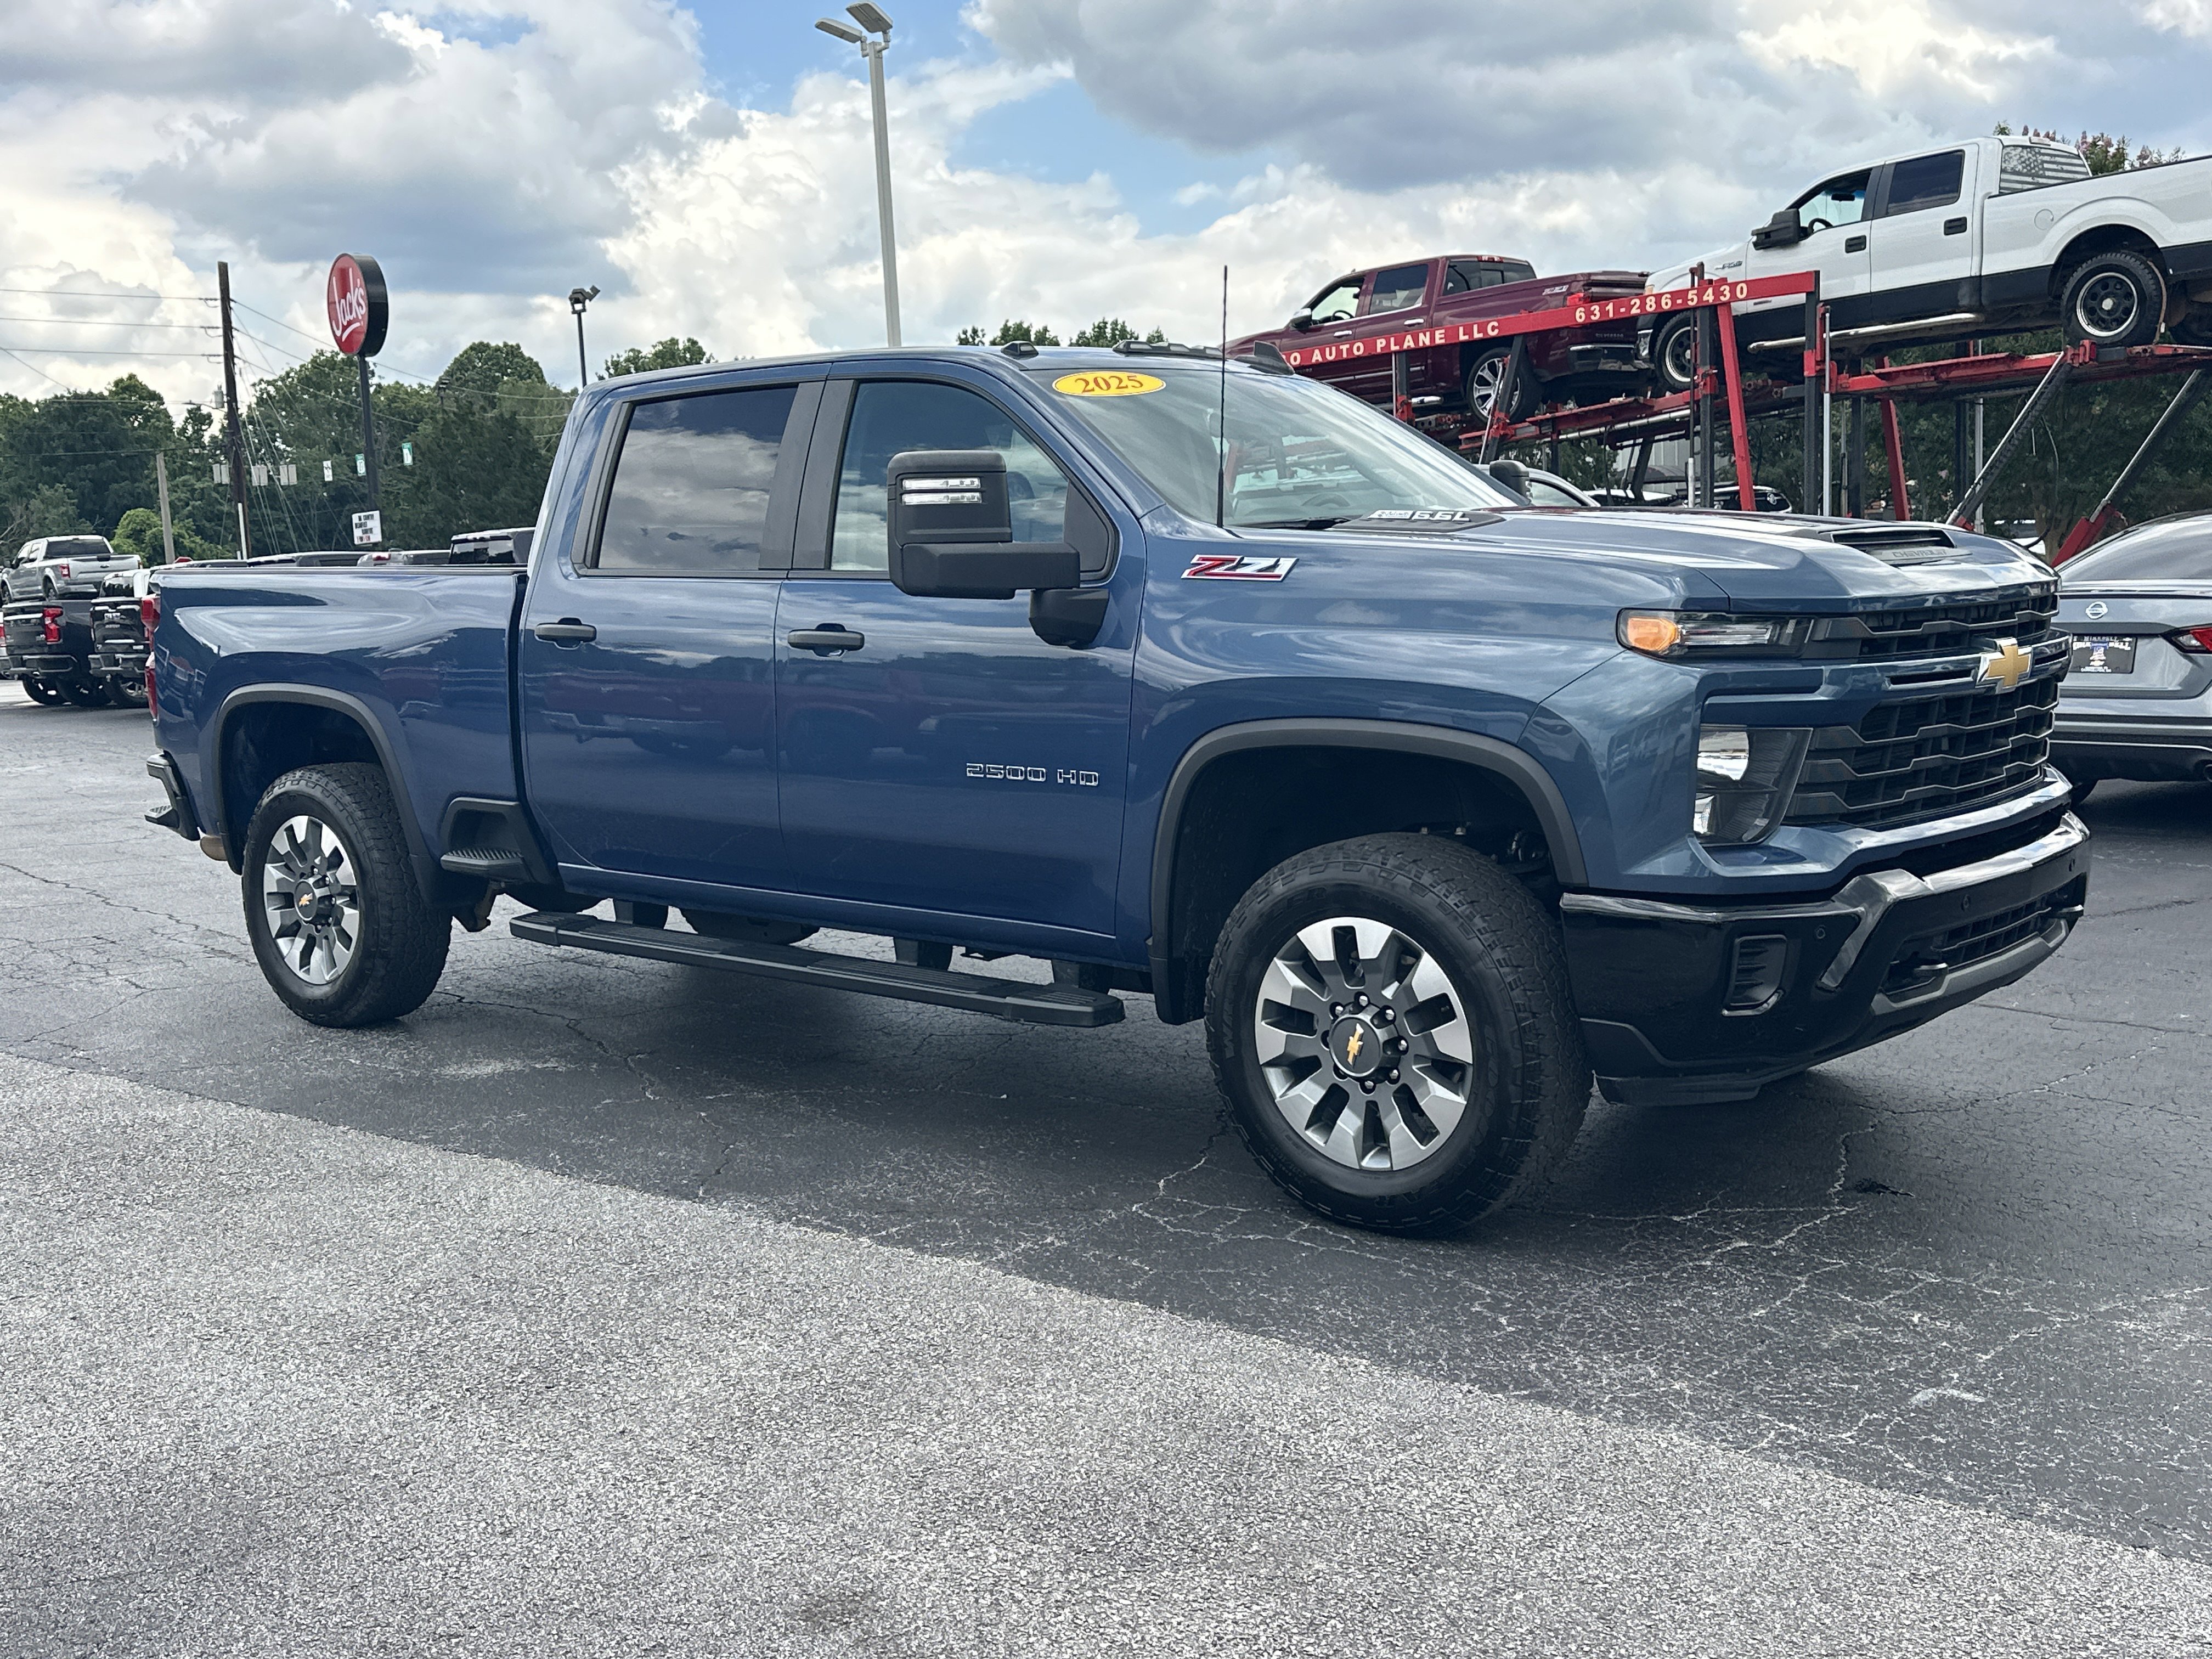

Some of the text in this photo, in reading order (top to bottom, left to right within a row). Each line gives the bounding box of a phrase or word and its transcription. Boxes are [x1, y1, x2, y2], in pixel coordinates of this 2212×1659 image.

[332, 267, 366, 337] Jack's
[1575, 282, 1748, 323] 631-286-5430
[1282, 321, 1499, 365] O AUTO PLANE LLC
[1074, 375, 1144, 394] 2025
[1411, 510, 1471, 522] 6.6L
[1891, 549, 1947, 558] CHEVROLET
[1181, 554, 1299, 582] Z71
[966, 763, 1099, 787] 2500 HD
